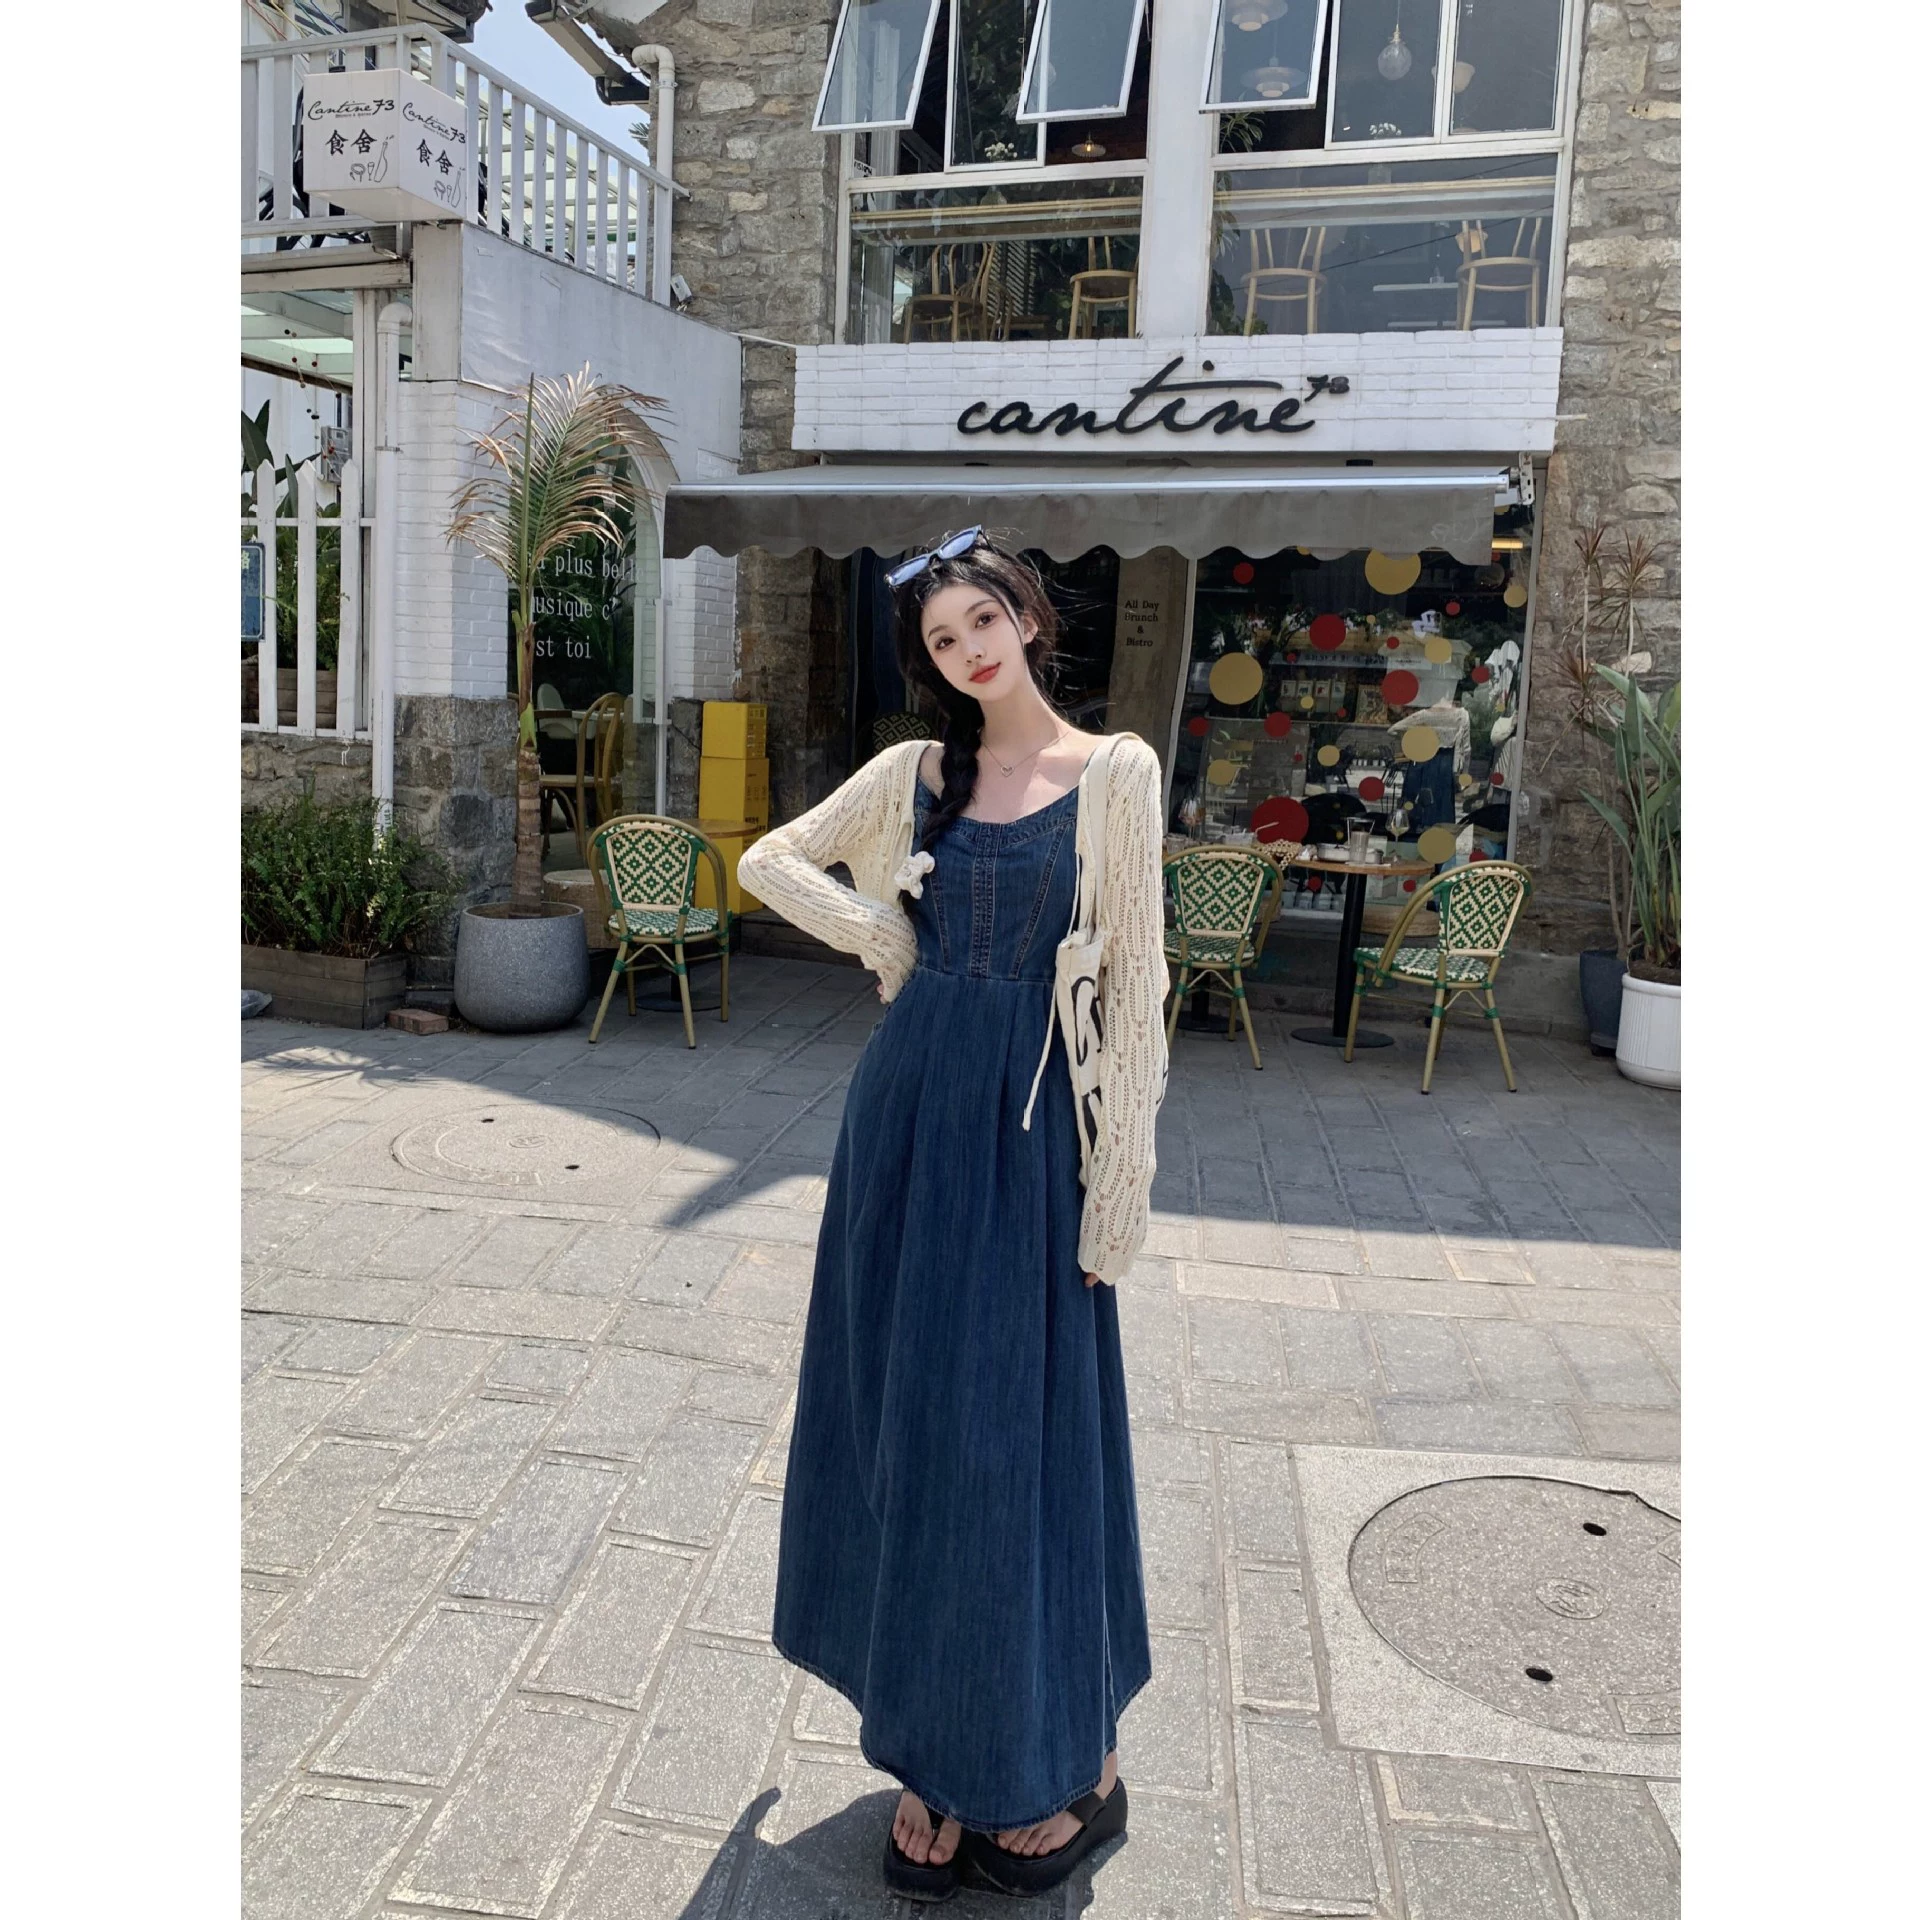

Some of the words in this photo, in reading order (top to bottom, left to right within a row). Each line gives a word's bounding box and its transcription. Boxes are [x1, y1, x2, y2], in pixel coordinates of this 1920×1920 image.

[325, 128, 378, 156] 食舍
[957, 355, 1316, 437] cantine
[555, 549, 593, 577] plus
[532, 591, 593, 622] usique
[1142, 600, 1160, 612] Day
[1137, 625, 1144, 634] &
[565, 635, 592, 659] toi
